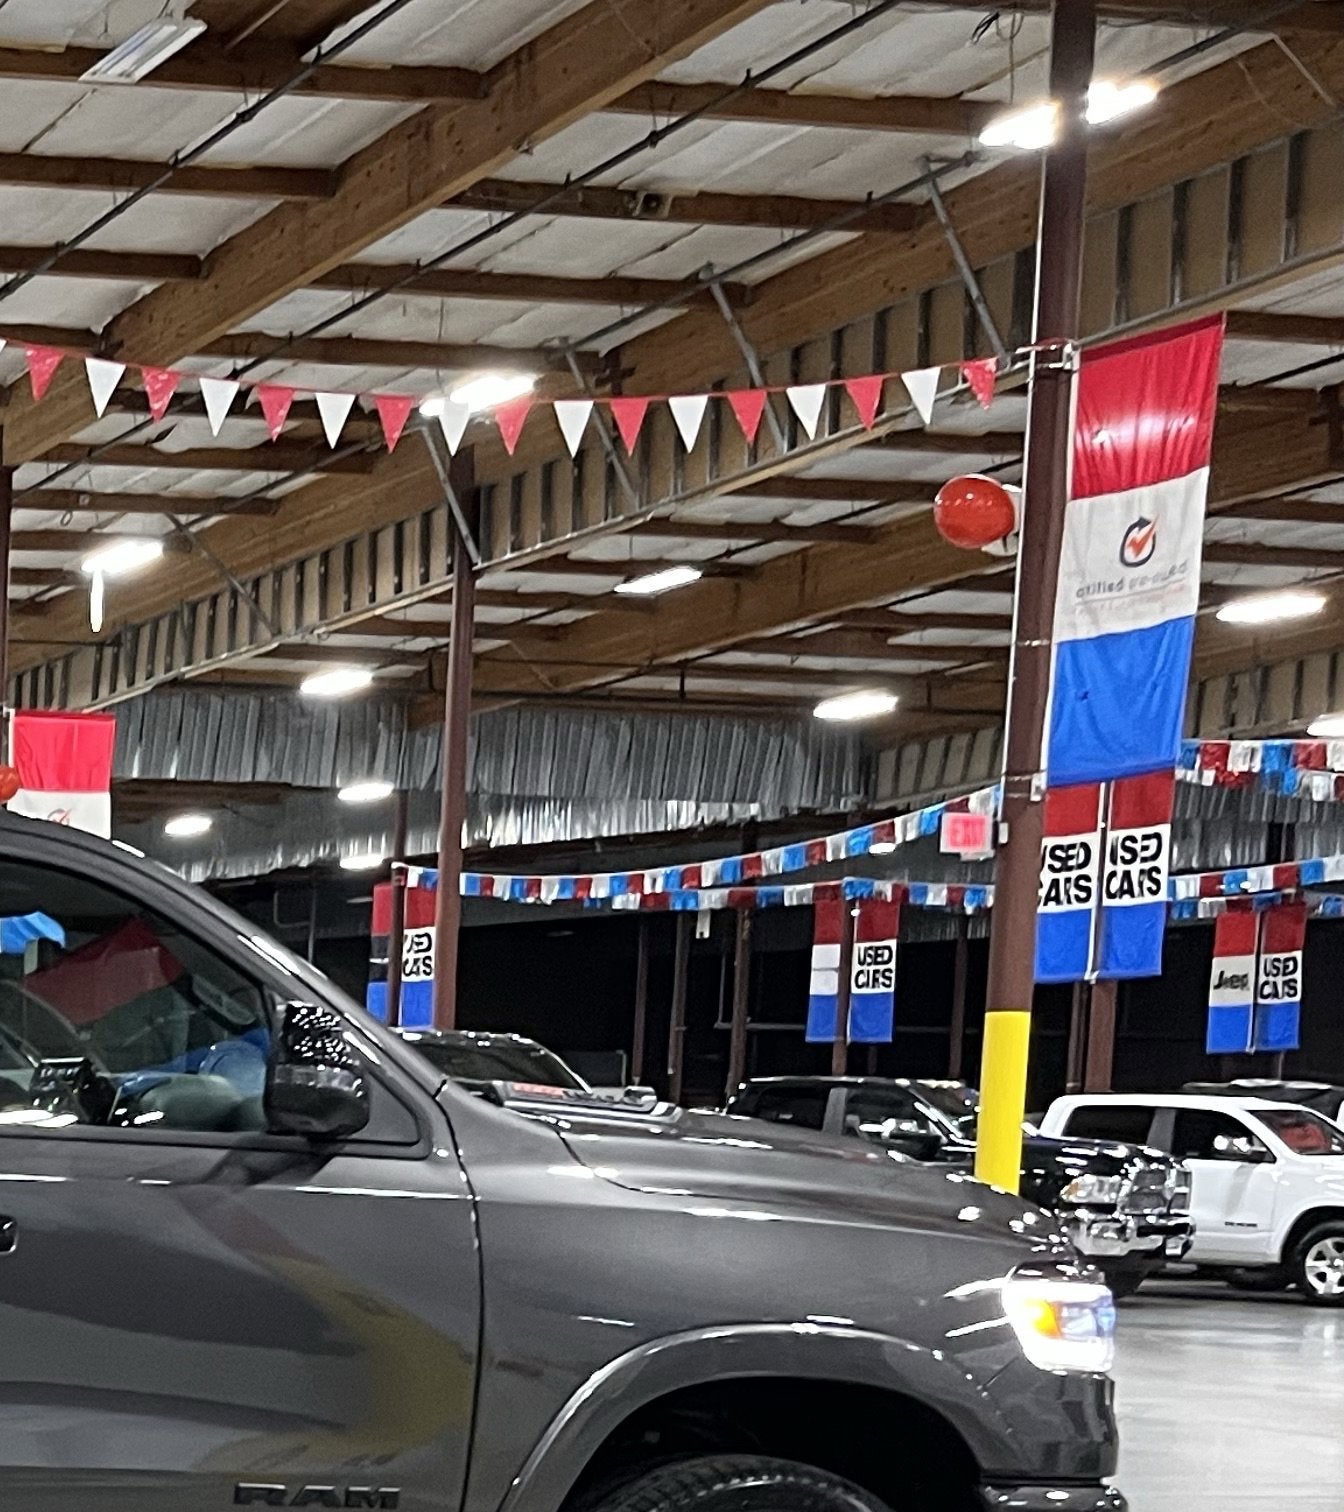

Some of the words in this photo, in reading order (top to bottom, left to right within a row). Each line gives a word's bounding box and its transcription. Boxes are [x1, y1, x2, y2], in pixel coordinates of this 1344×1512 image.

[1038, 873, 1092, 907] ARS
[857, 945, 894, 966] USED
[233, 1482, 402, 1510] RAM
